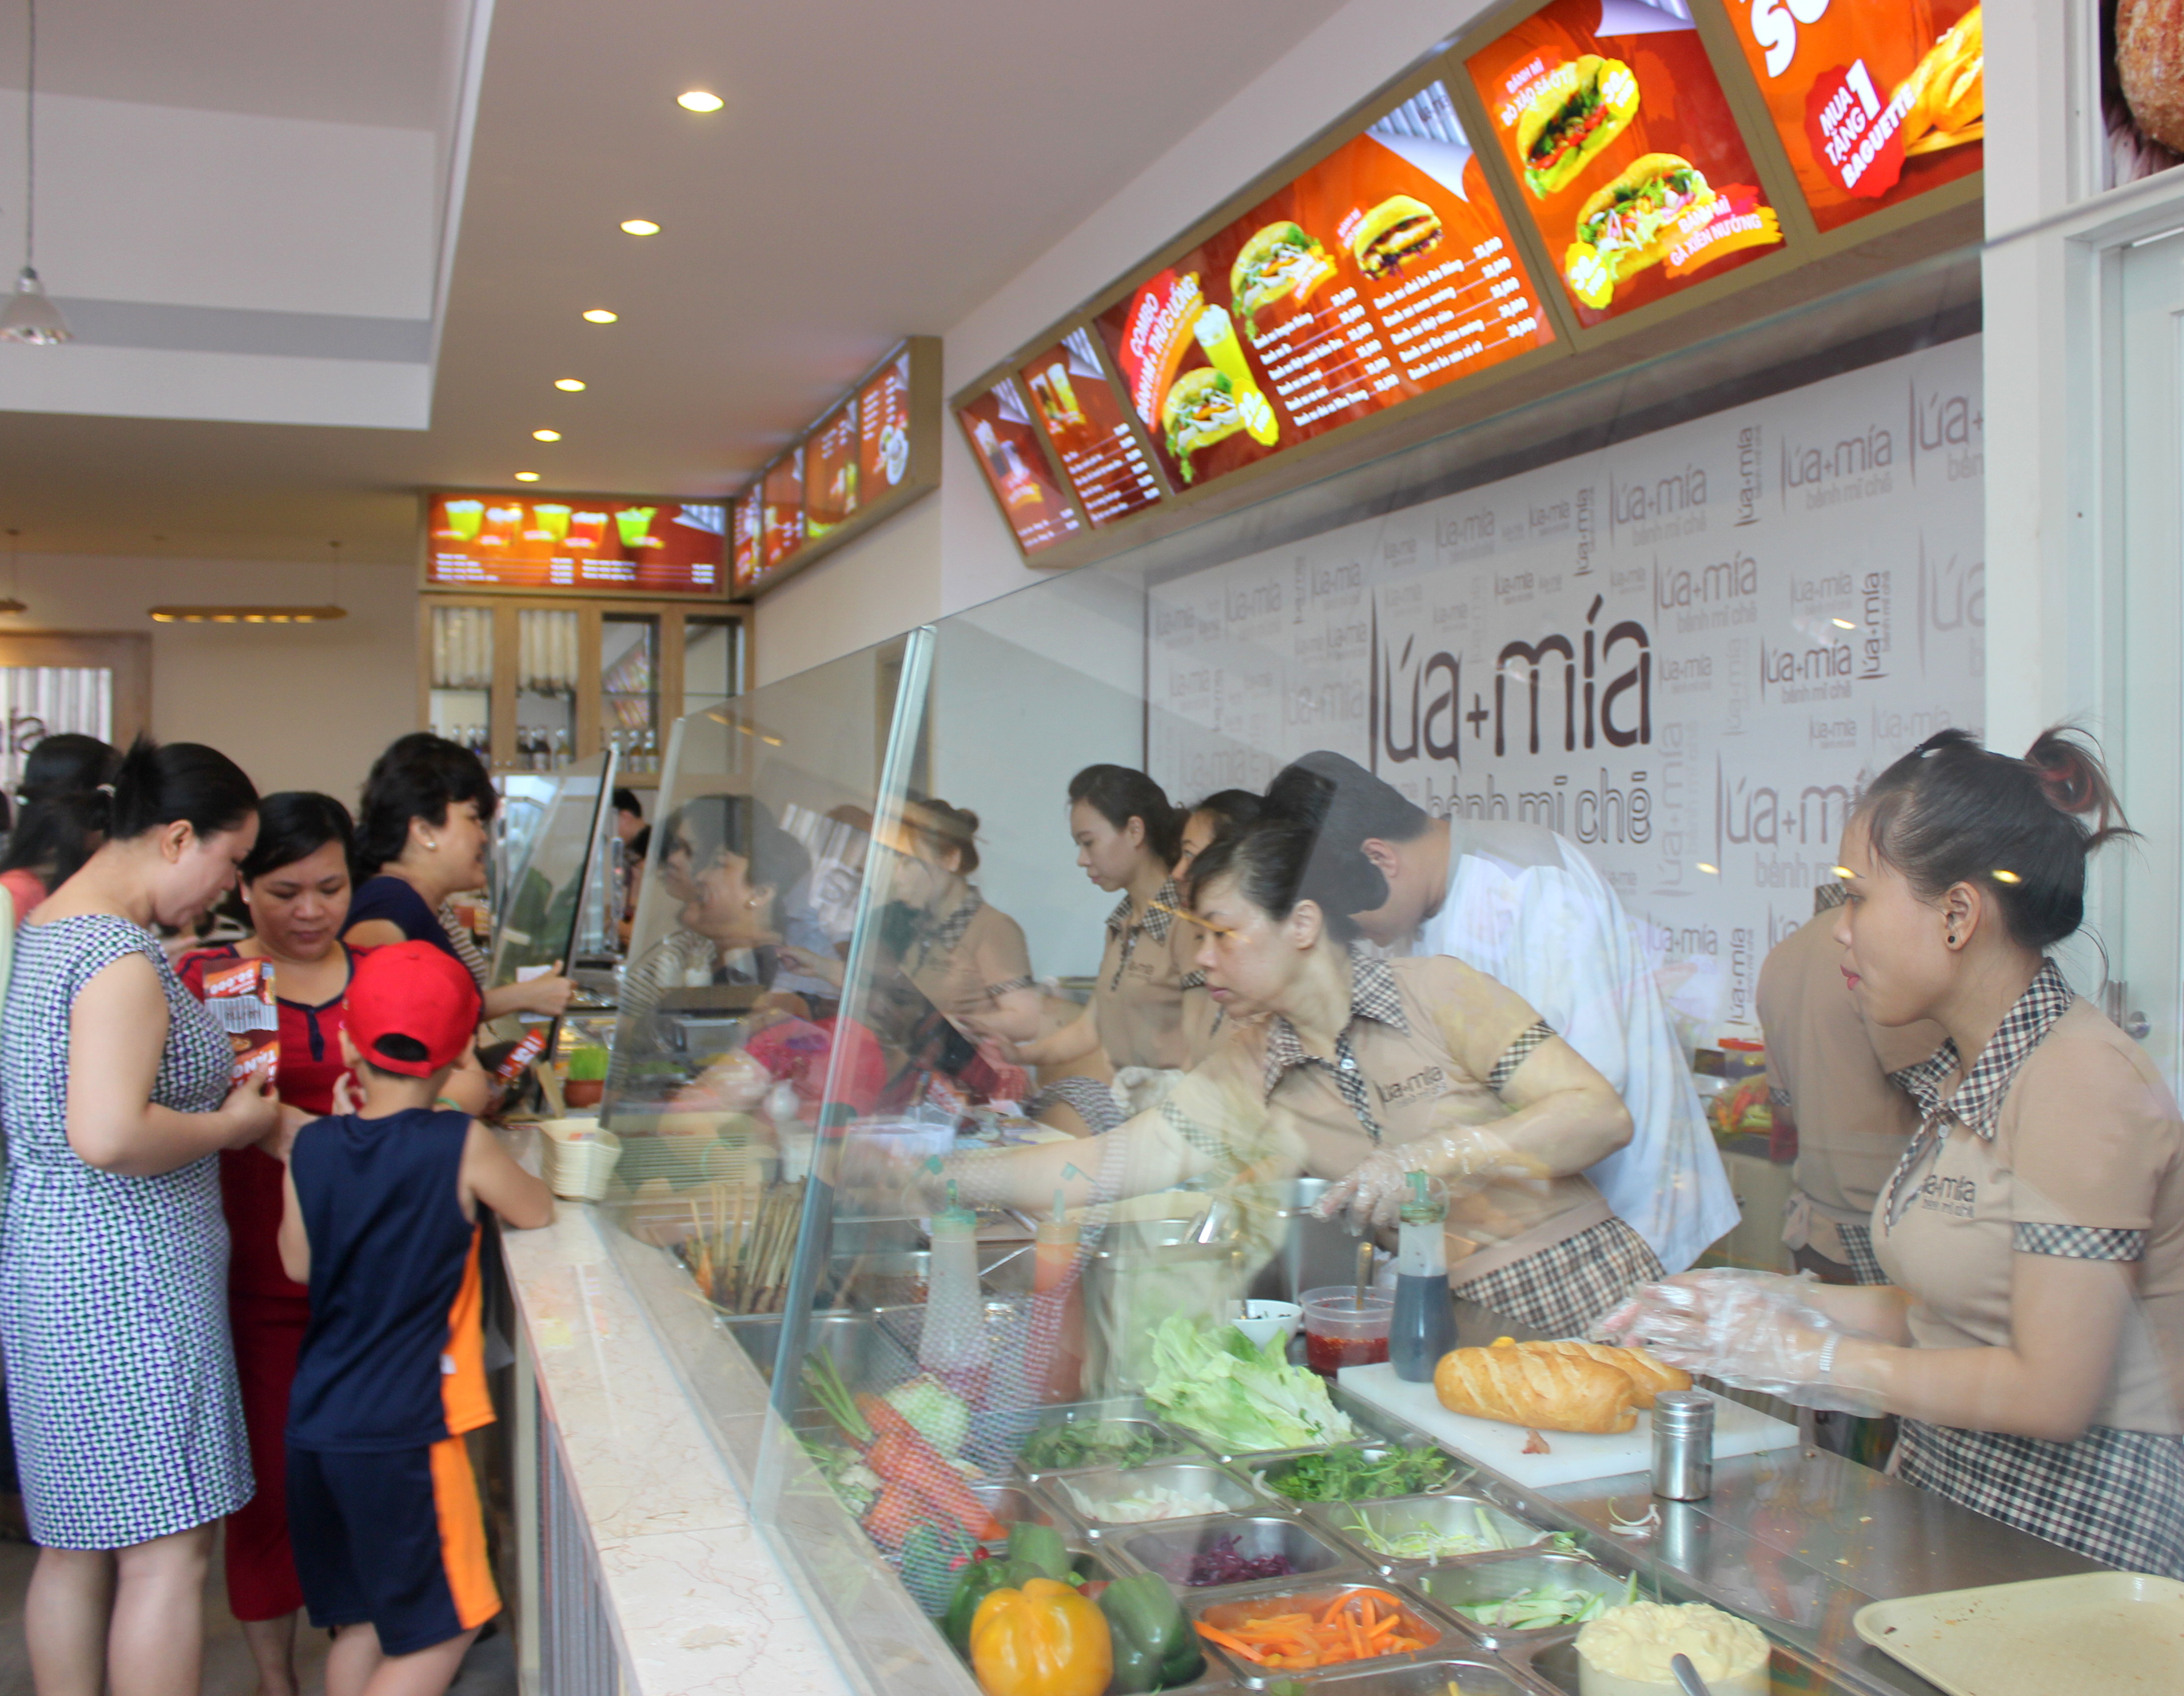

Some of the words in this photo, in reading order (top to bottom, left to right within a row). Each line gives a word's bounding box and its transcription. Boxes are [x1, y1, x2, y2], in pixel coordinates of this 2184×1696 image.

[1819, 87, 1853, 137] MUA
[1845, 58, 1881, 121] 1
[1824, 107, 1867, 166] TẶNG
[1841, 83, 1917, 188] BAGUETTE
[1608, 463, 1707, 549] lúa+mía
[1781, 424, 1892, 514] lúa+mía
[1653, 549, 1757, 634] lúa+mía
[1856, 572, 1890, 680] lúa+mía
[1369, 584, 1651, 775] lúa+mía
[1760, 635, 1852, 705] lúa+mía
